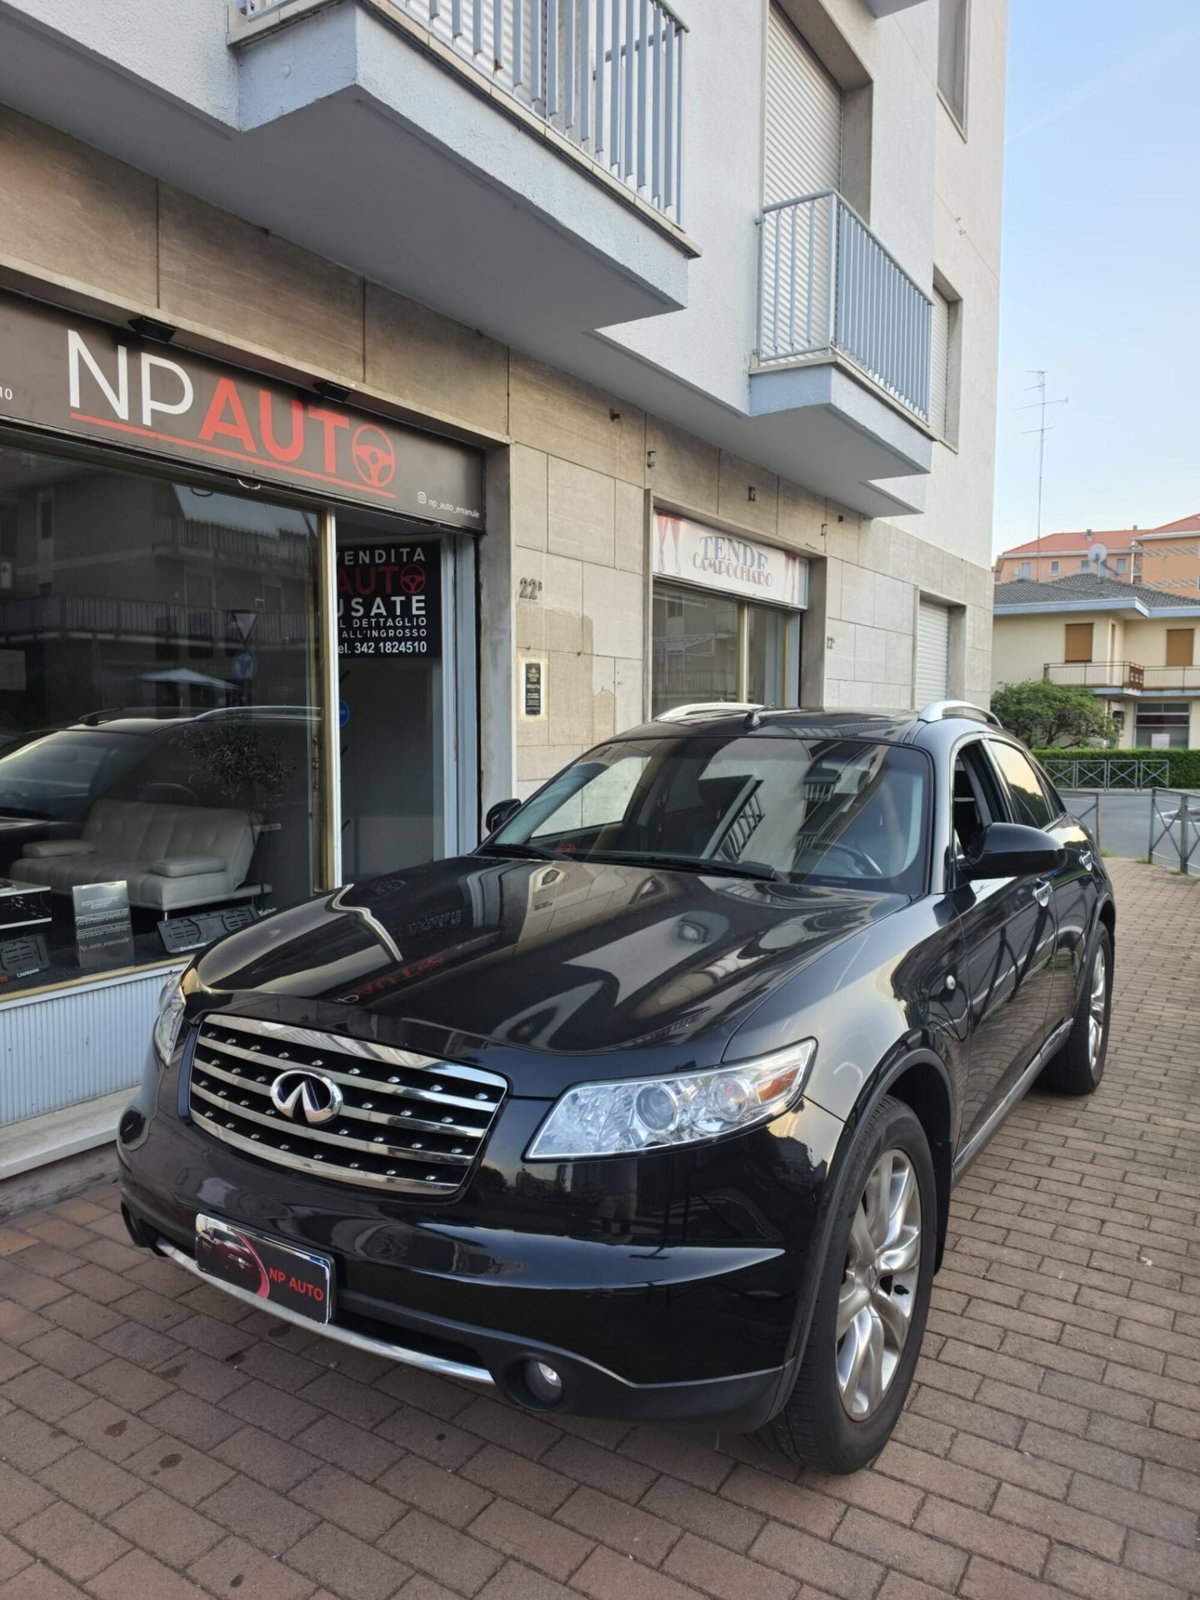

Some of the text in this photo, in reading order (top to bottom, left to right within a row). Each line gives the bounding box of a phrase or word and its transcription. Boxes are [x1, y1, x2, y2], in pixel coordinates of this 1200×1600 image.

[352, 617, 427, 628] DETTAGLIO
[341, 628, 427, 638] ALL'INGROSSO
[354, 642, 375, 654] 342
[378, 641, 427, 654] 1824510
[269, 1266, 324, 1302] NP AUTO
